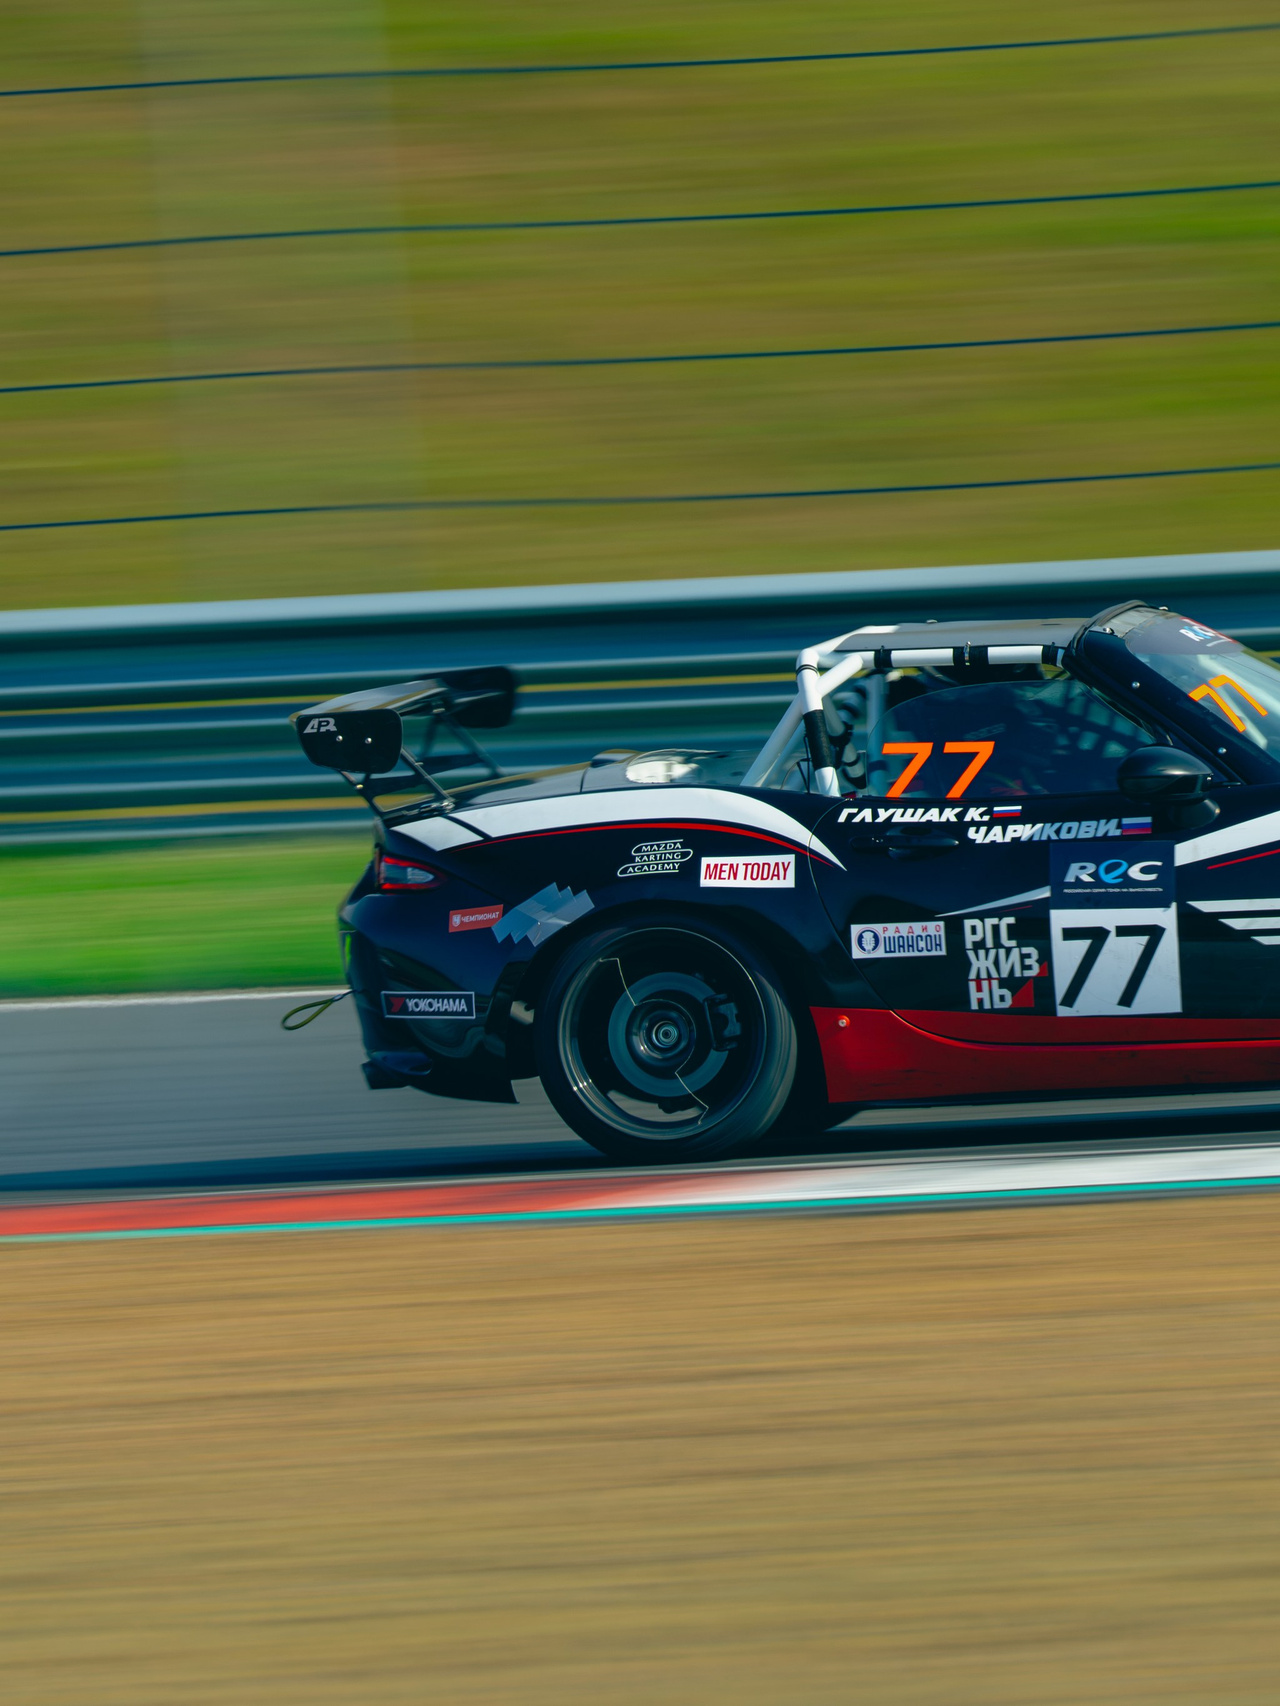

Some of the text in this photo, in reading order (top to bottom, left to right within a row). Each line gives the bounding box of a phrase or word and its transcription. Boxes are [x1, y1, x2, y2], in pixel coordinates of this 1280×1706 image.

[1187, 674, 1268, 733] 77
[881, 741, 995, 799] 77
[837, 807, 990, 823] ГЛУШАК К.
[641, 842, 682, 852] MAZDA
[627, 862, 681, 873] ACADEMY
[634, 852, 682, 863] KARTING
[704, 861, 791, 881] MEN TODAY
[461, 911, 500, 923] ЧЕМПИОНАТ
[882, 924, 942, 935] РАДИО
[963, 917, 1017, 949] РГС
[883, 934, 943, 954] ШАНСОН
[966, 946, 1040, 980] ЖИЗ
[1058, 923, 1167, 1008] 77
[968, 978, 1013, 1010] НЬ
[405, 998, 468, 1012] YOKOHAMA
